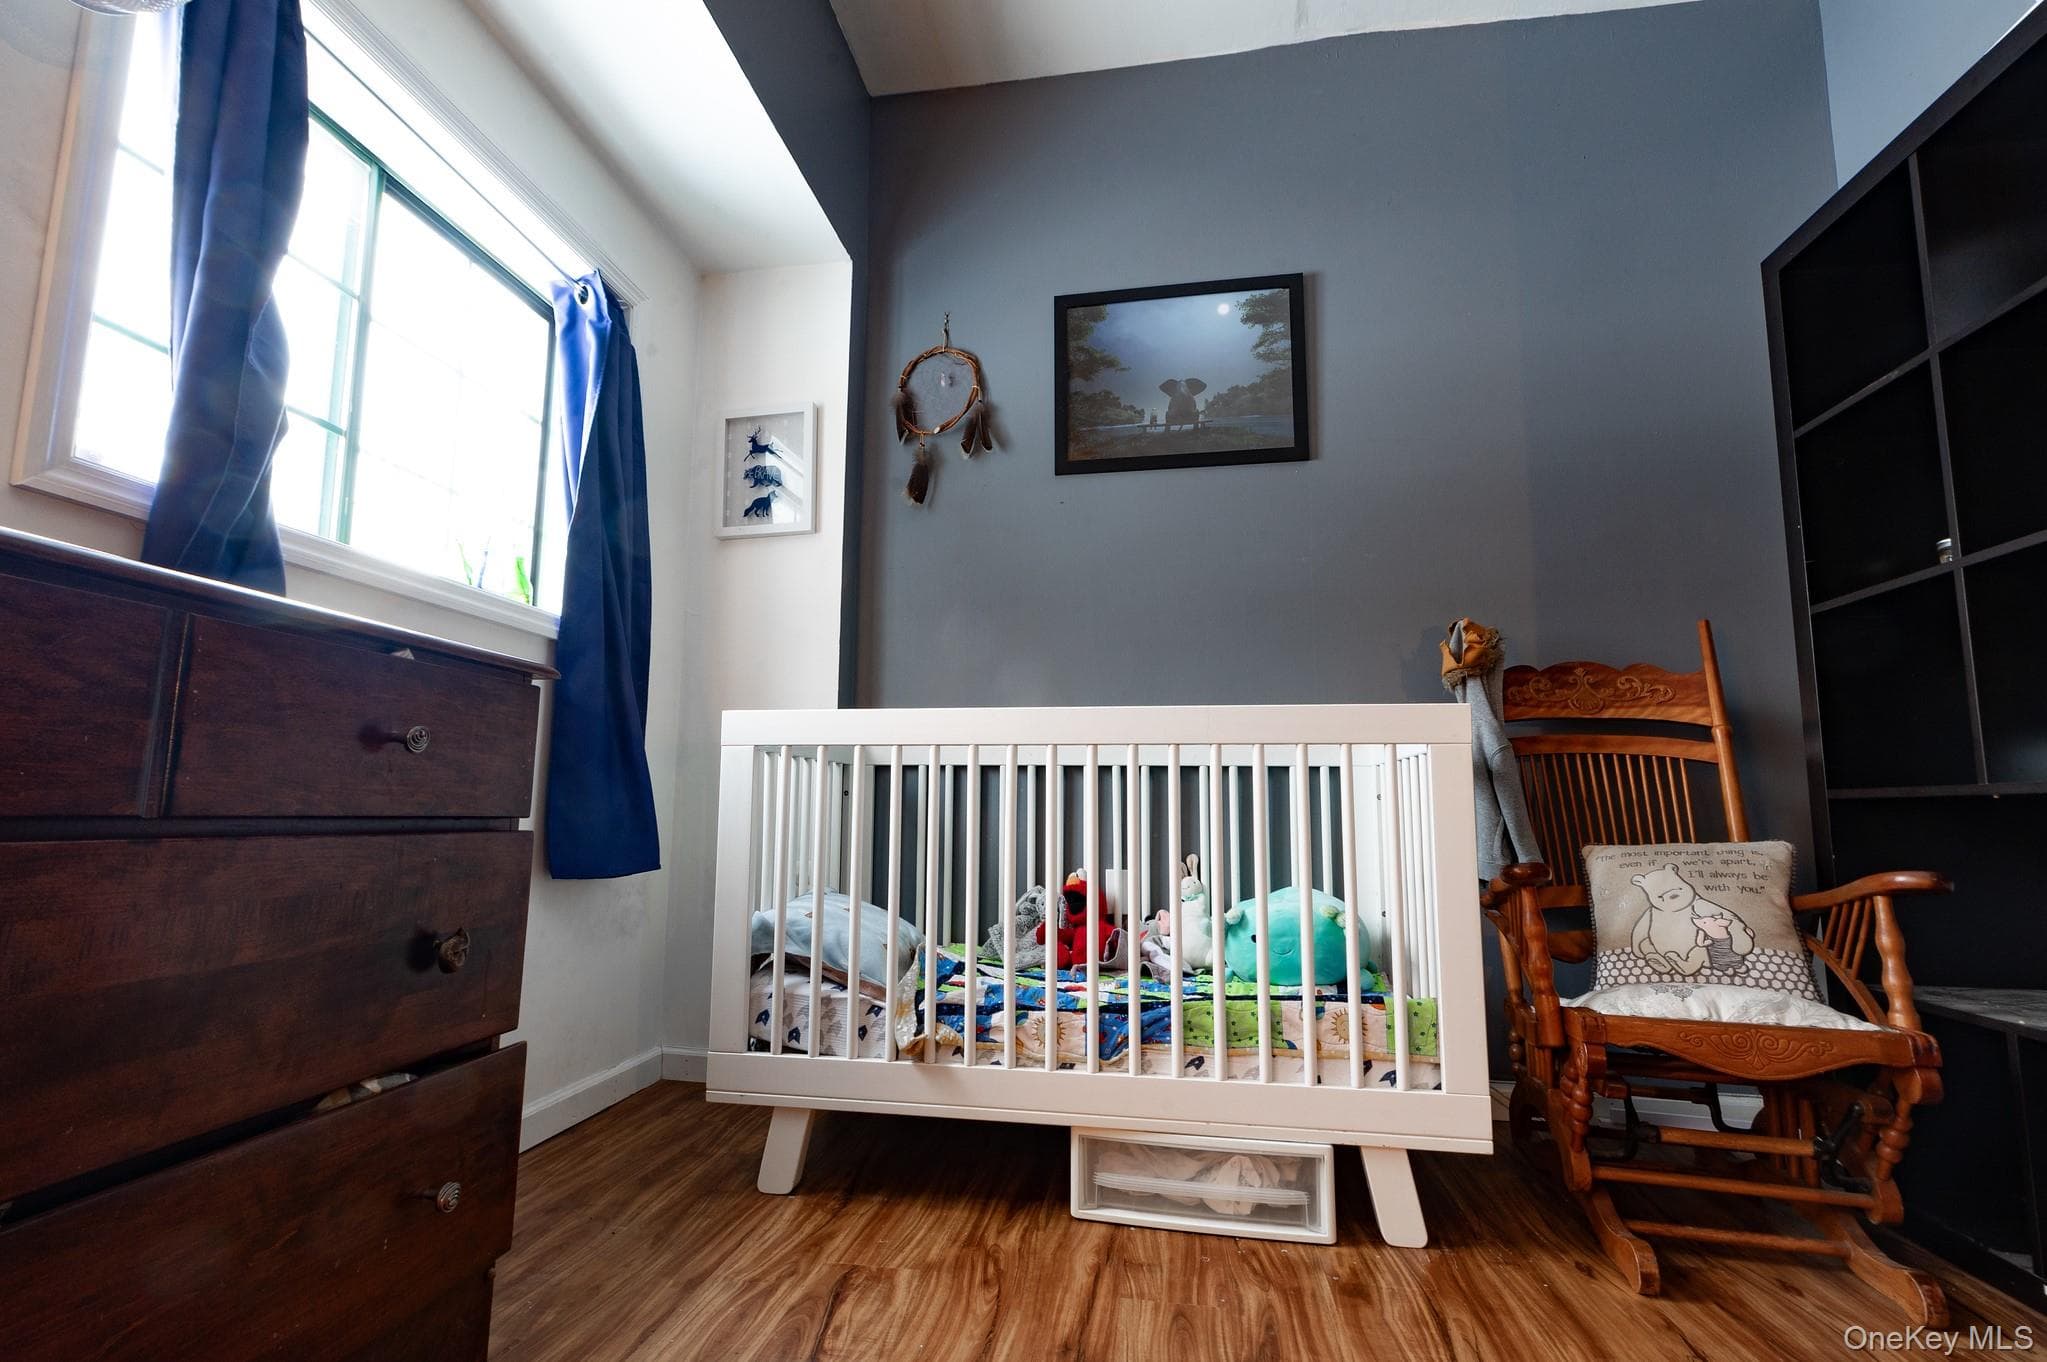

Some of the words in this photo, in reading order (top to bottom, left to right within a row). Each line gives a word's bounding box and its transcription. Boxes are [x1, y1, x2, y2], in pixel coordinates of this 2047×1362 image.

[1620, 850, 1648, 858] most
[1654, 849, 1710, 858] important
[1619, 860, 1643, 869] even
[1648, 859, 1658, 867] if
[1682, 858, 1713, 866] we're
[1720, 858, 1756, 867] apart,
[1688, 869, 1704, 879] I'll
[1709, 870, 1748, 881] always
[1752, 871, 1768, 881] be
[1704, 883, 1731, 892] with
